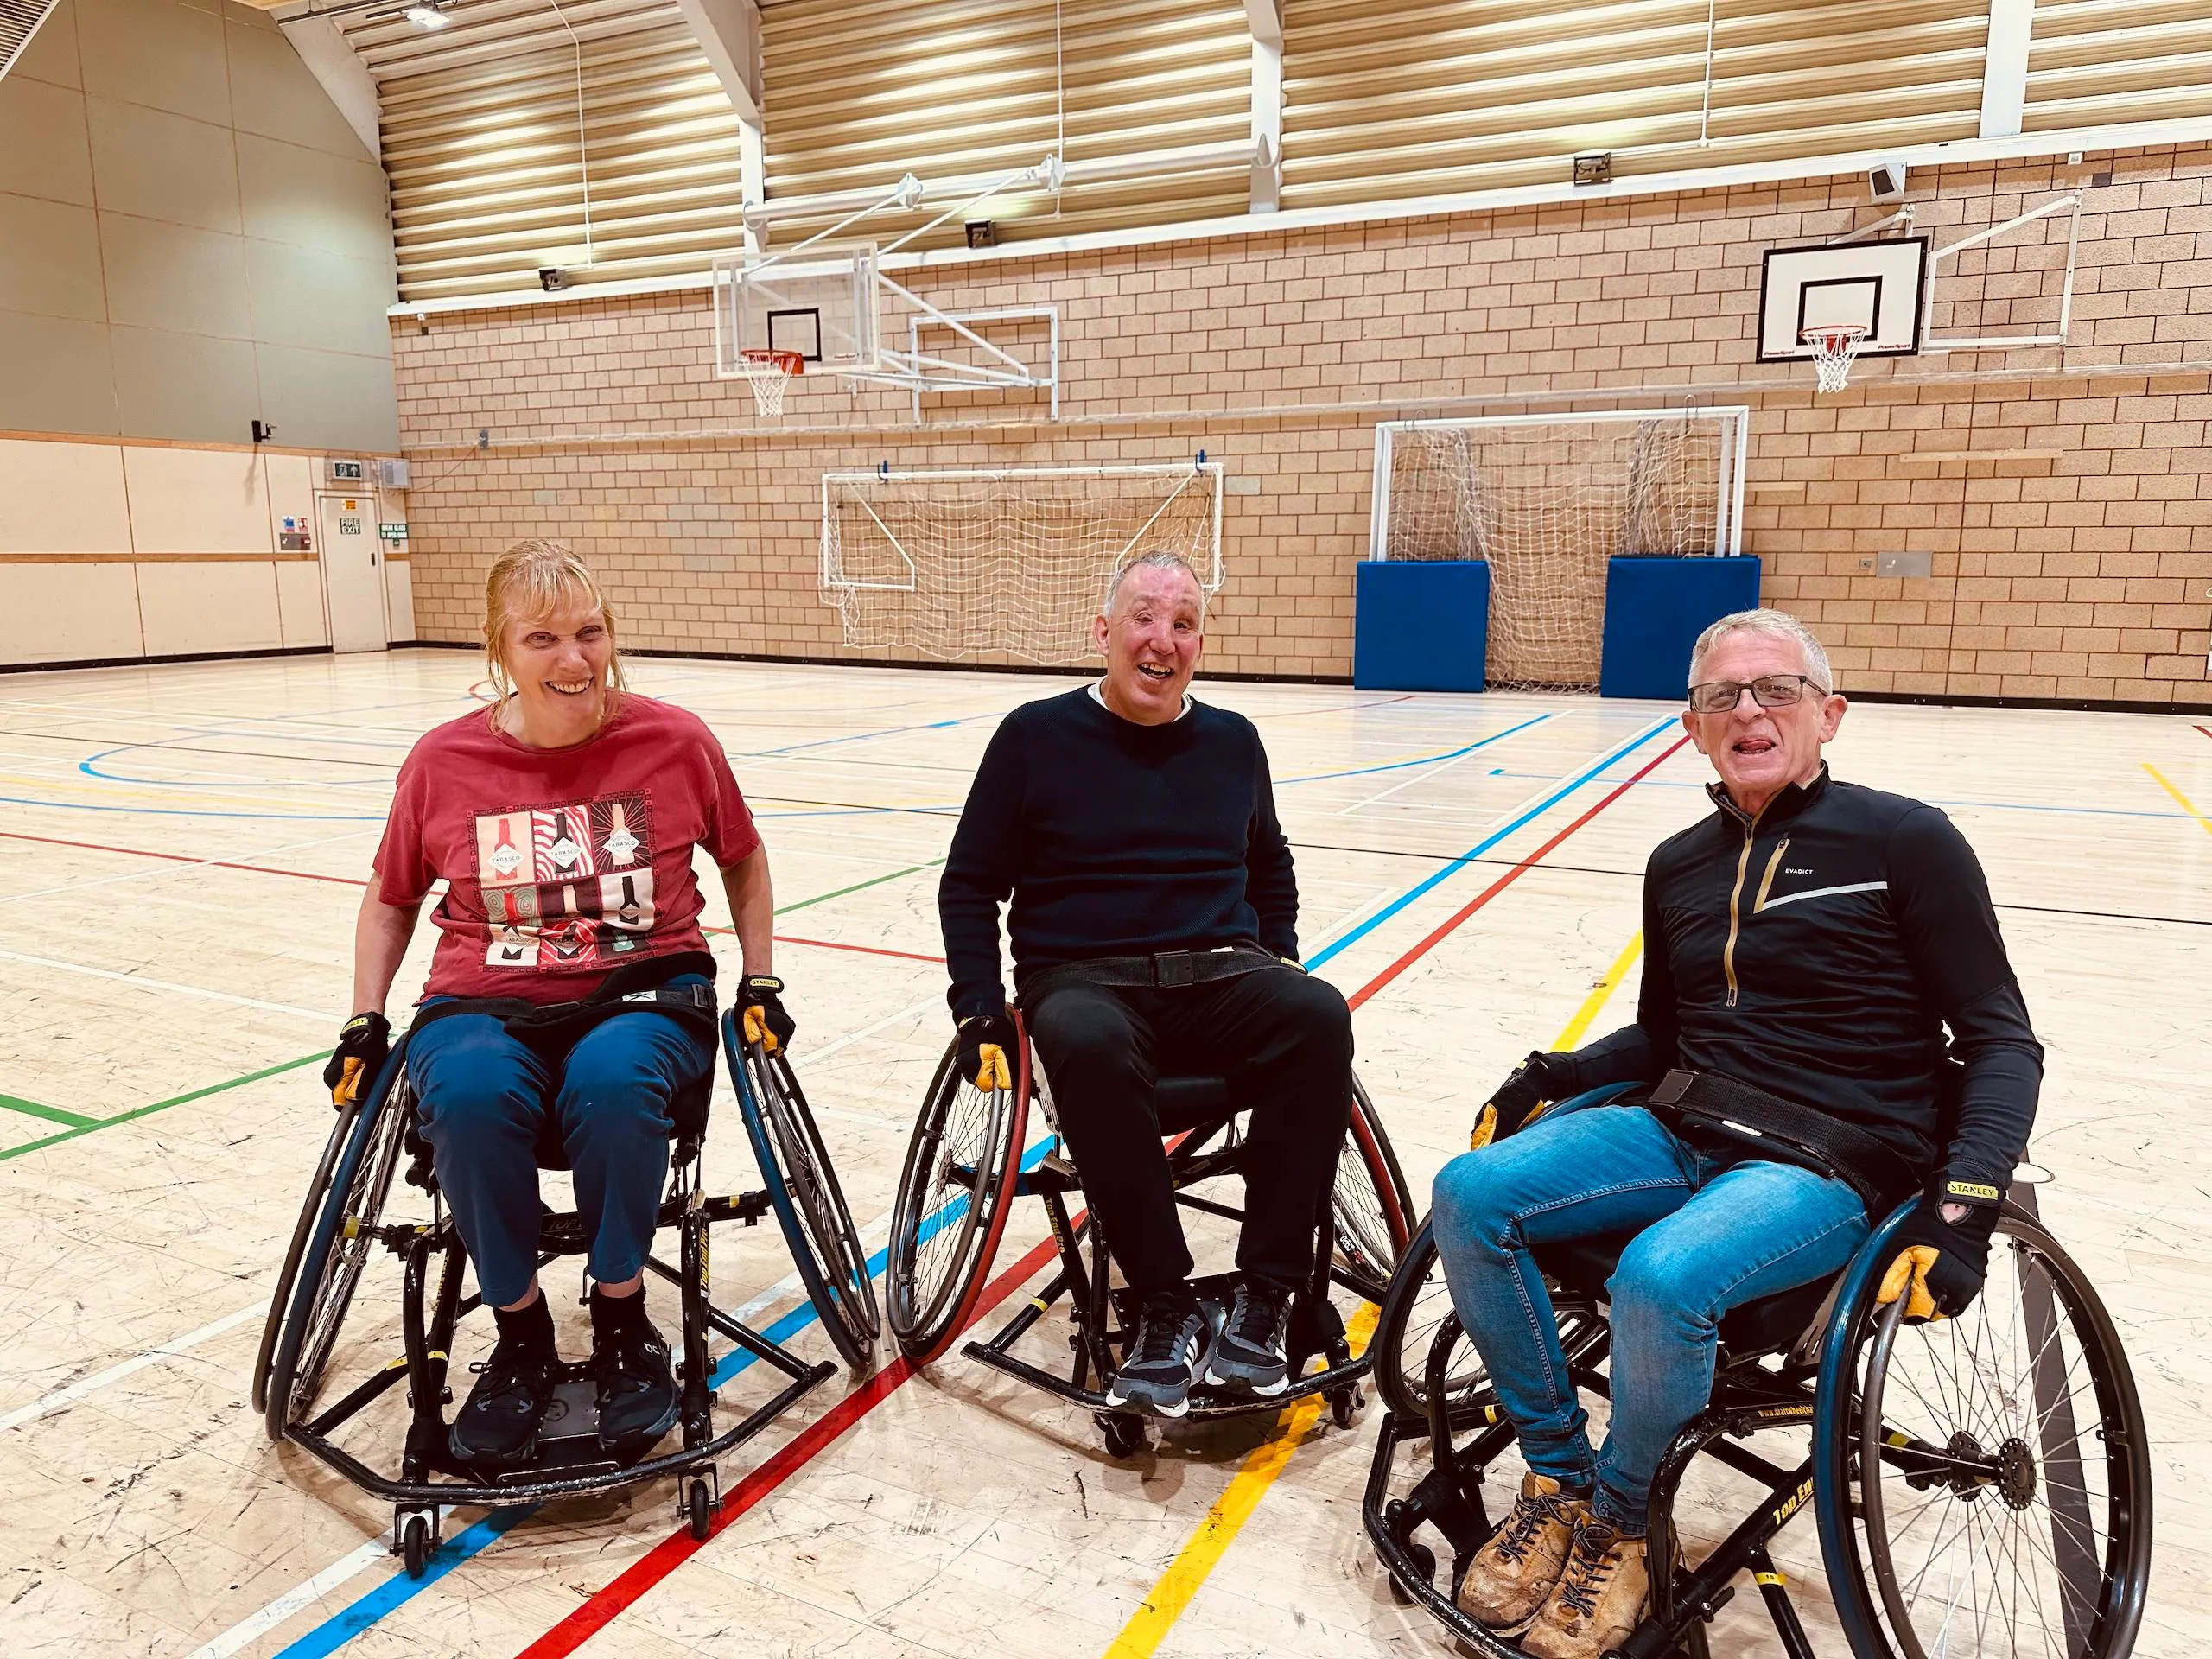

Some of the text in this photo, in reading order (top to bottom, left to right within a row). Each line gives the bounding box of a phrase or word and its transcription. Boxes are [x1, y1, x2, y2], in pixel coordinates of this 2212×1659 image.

[550, 848, 579, 856] TABASCO
[1951, 1184, 1994, 1196] STANLEY
[1773, 1495, 1796, 1526] Top
